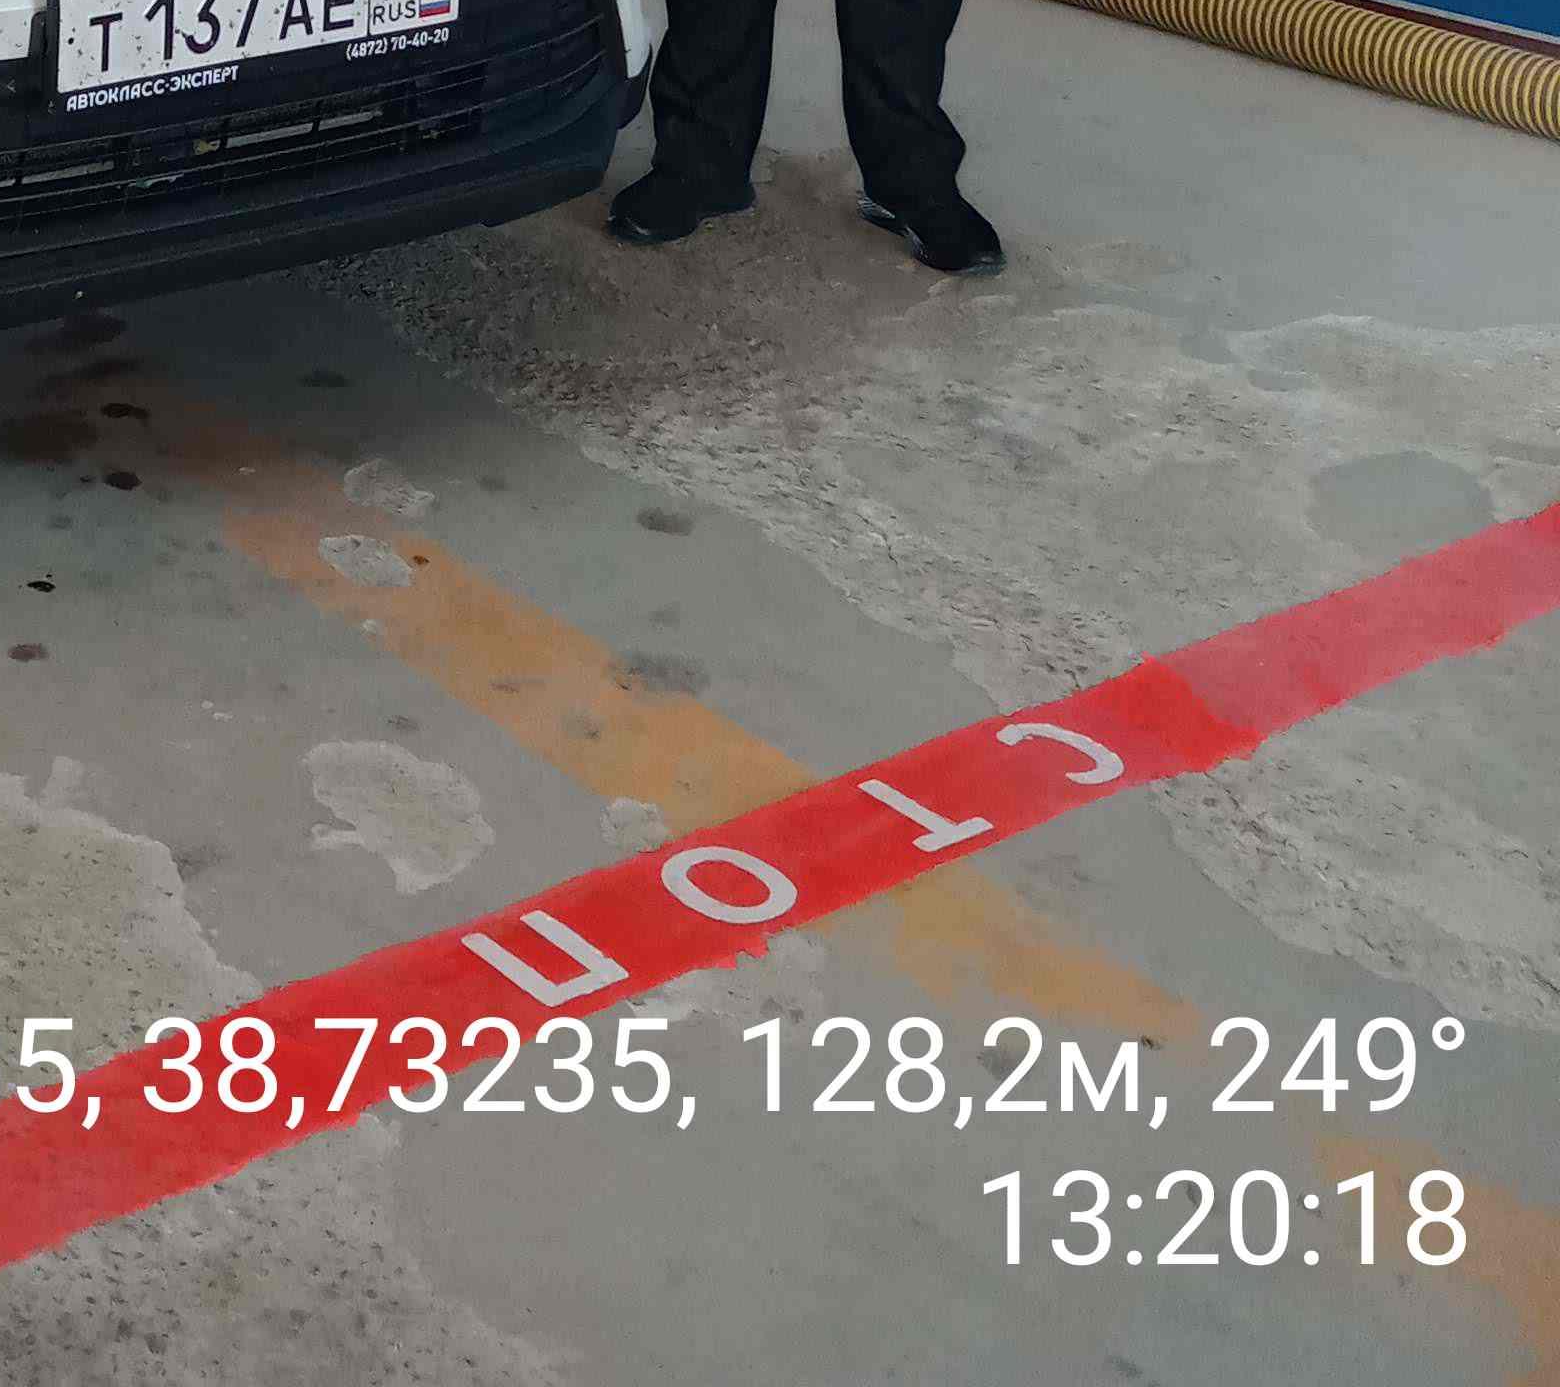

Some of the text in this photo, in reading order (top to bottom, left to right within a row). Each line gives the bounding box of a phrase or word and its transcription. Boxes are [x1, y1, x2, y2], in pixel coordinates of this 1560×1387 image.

[372, 0, 416, 25] RUS
[345, 27, 450, 61] (4872) 70-40-20
[460, 722, 1125, 1008] СТОП
